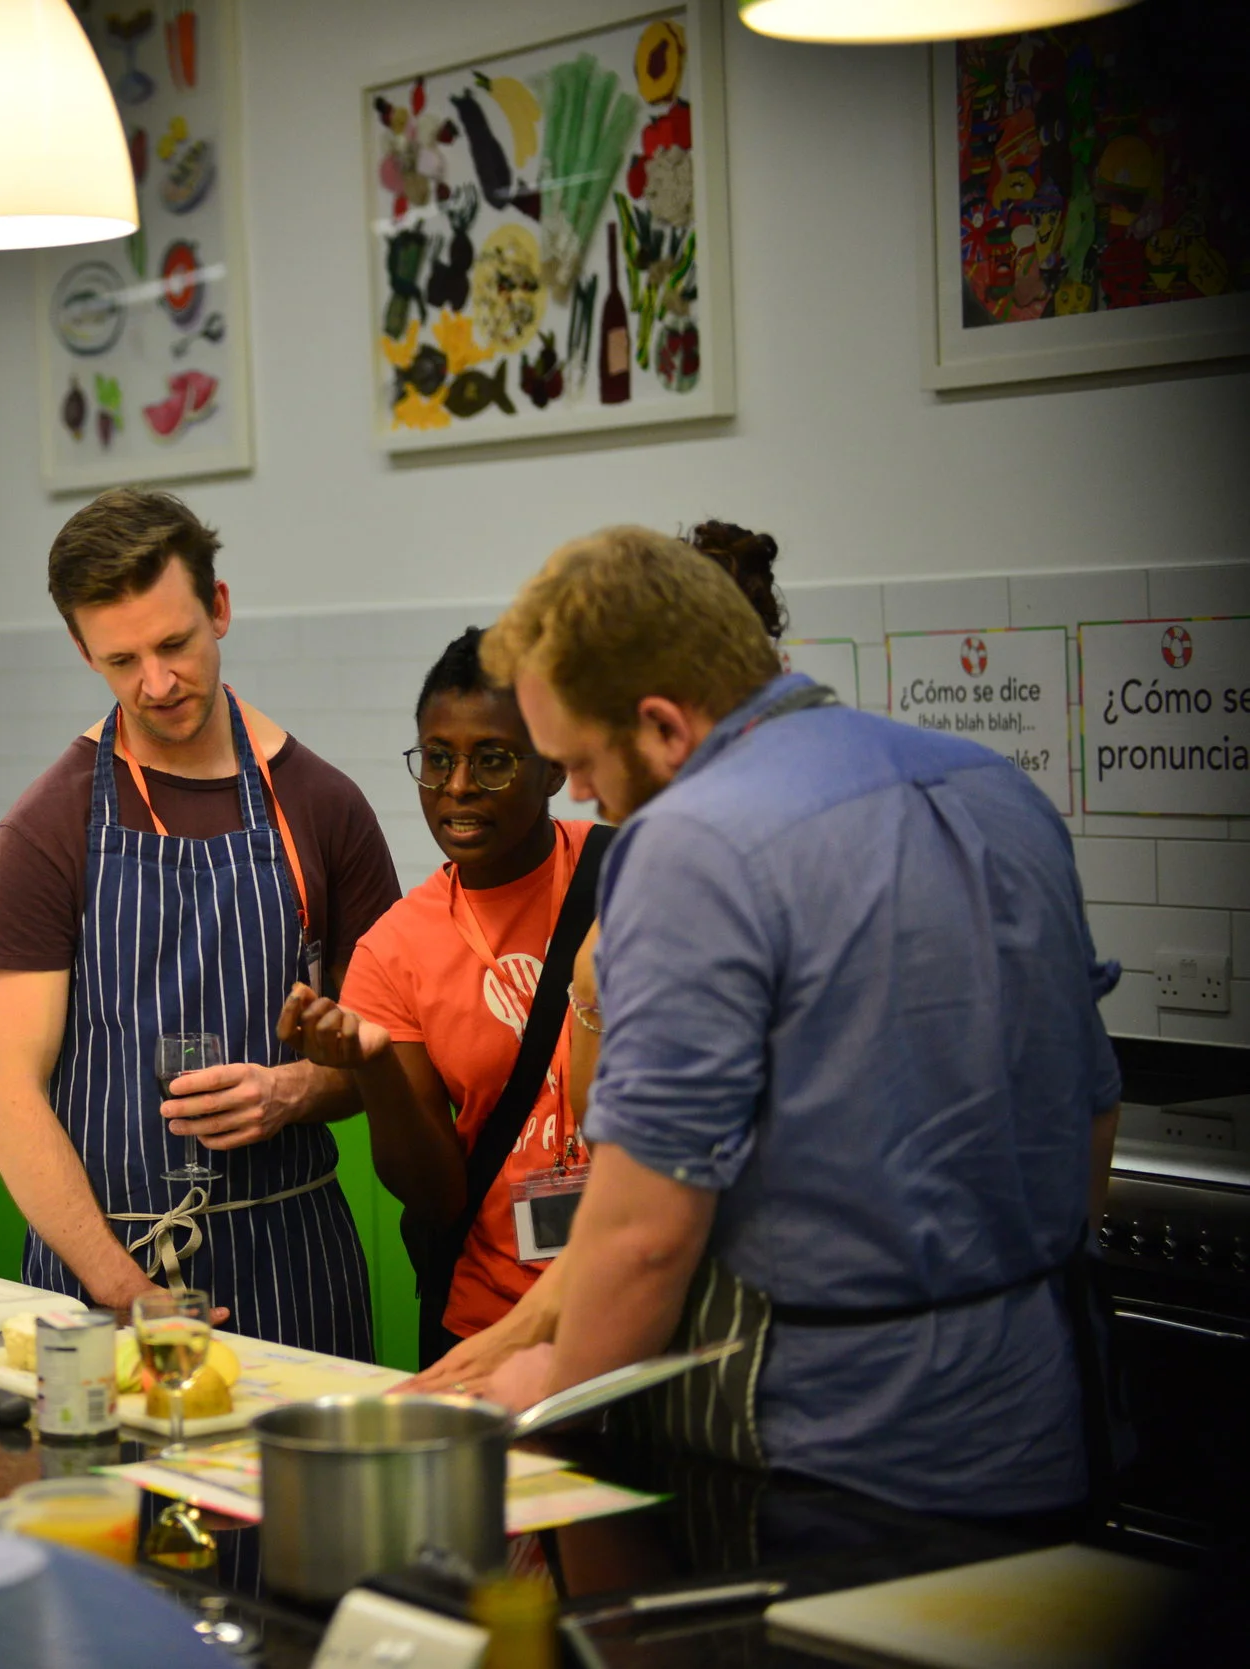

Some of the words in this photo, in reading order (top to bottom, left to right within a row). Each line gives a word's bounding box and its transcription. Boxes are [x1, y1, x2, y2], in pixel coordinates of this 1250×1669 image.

[900, 678, 967, 712] ¿Cómo
[973, 684, 994, 703] se
[1000, 676, 1041, 702] dice
[1104, 678, 1212, 725] ¿Cómo
[1223, 688, 1250, 714] se
[955, 713, 984, 732] blah
[1098, 735, 1249, 782] pronuncia
